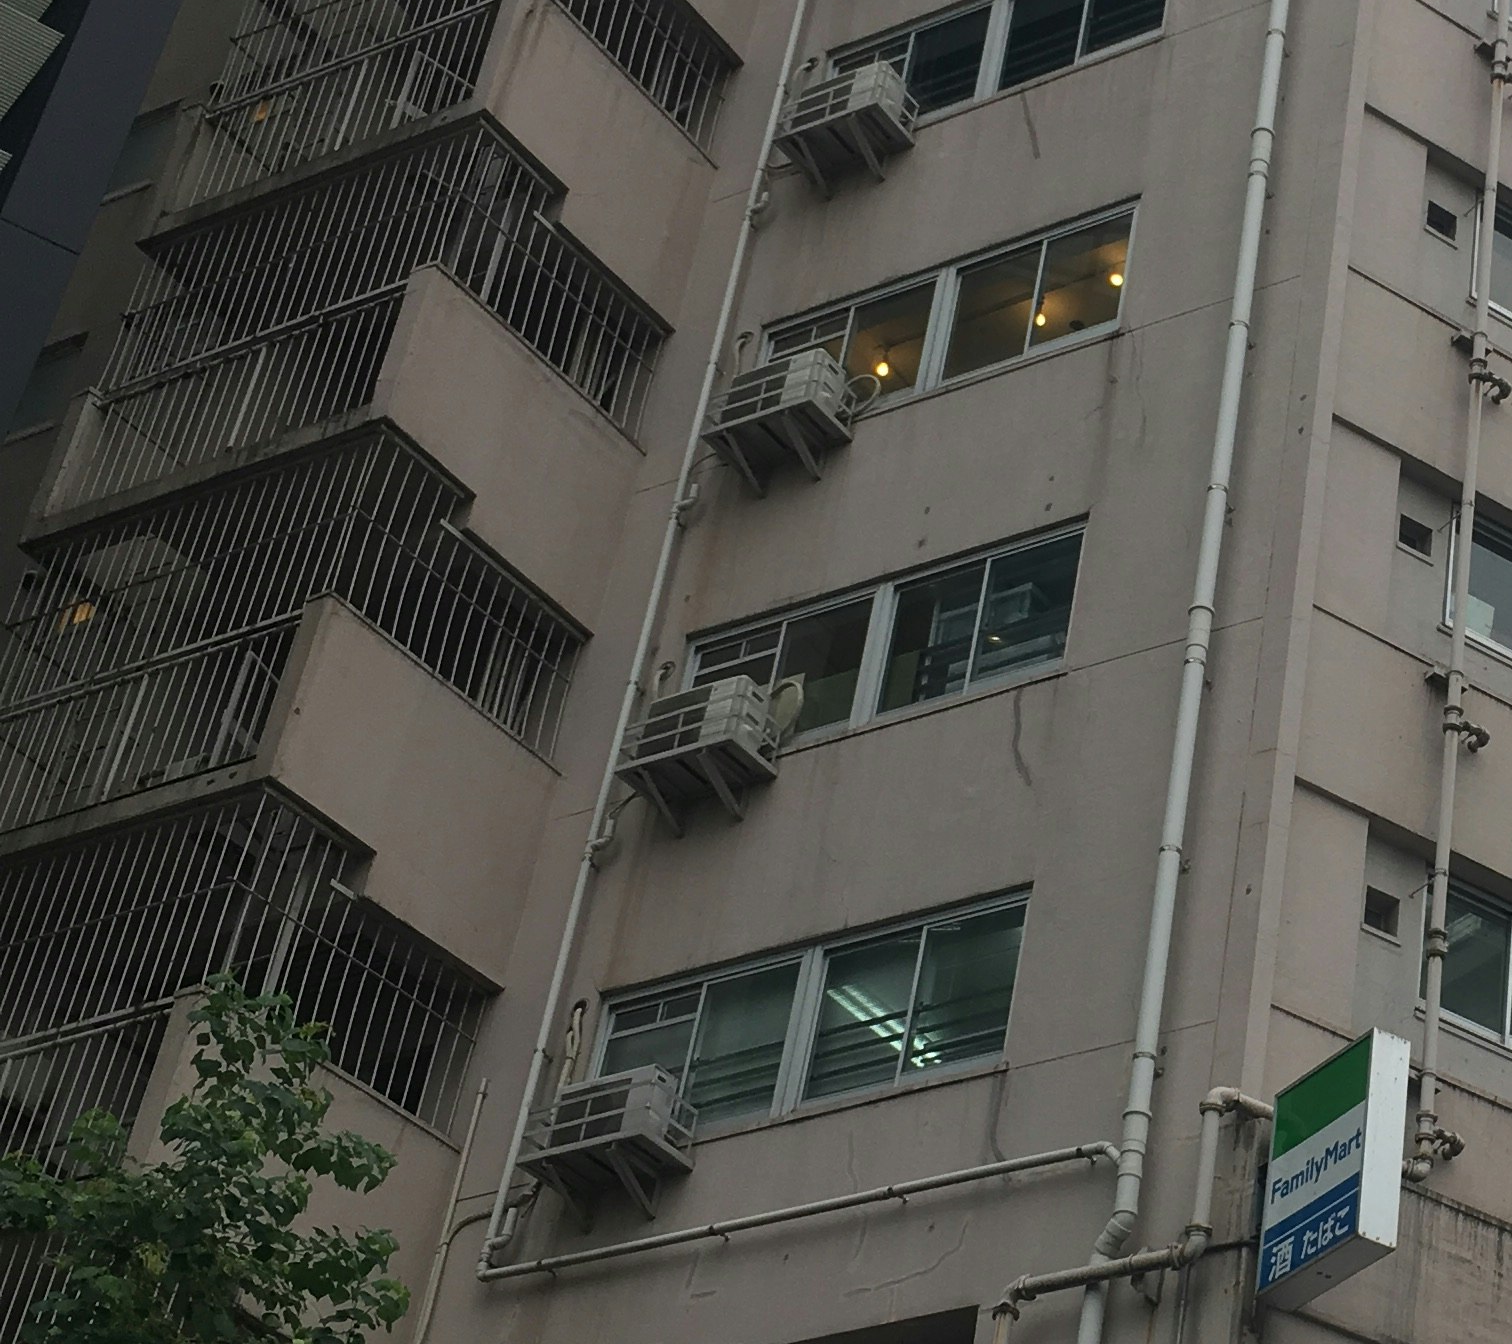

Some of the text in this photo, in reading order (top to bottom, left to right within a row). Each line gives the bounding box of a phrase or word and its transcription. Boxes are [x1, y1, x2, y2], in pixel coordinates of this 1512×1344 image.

[1270, 1127, 1362, 1205] FamilyMart
[1268, 1205, 1350, 1282] 酒 たばこ
